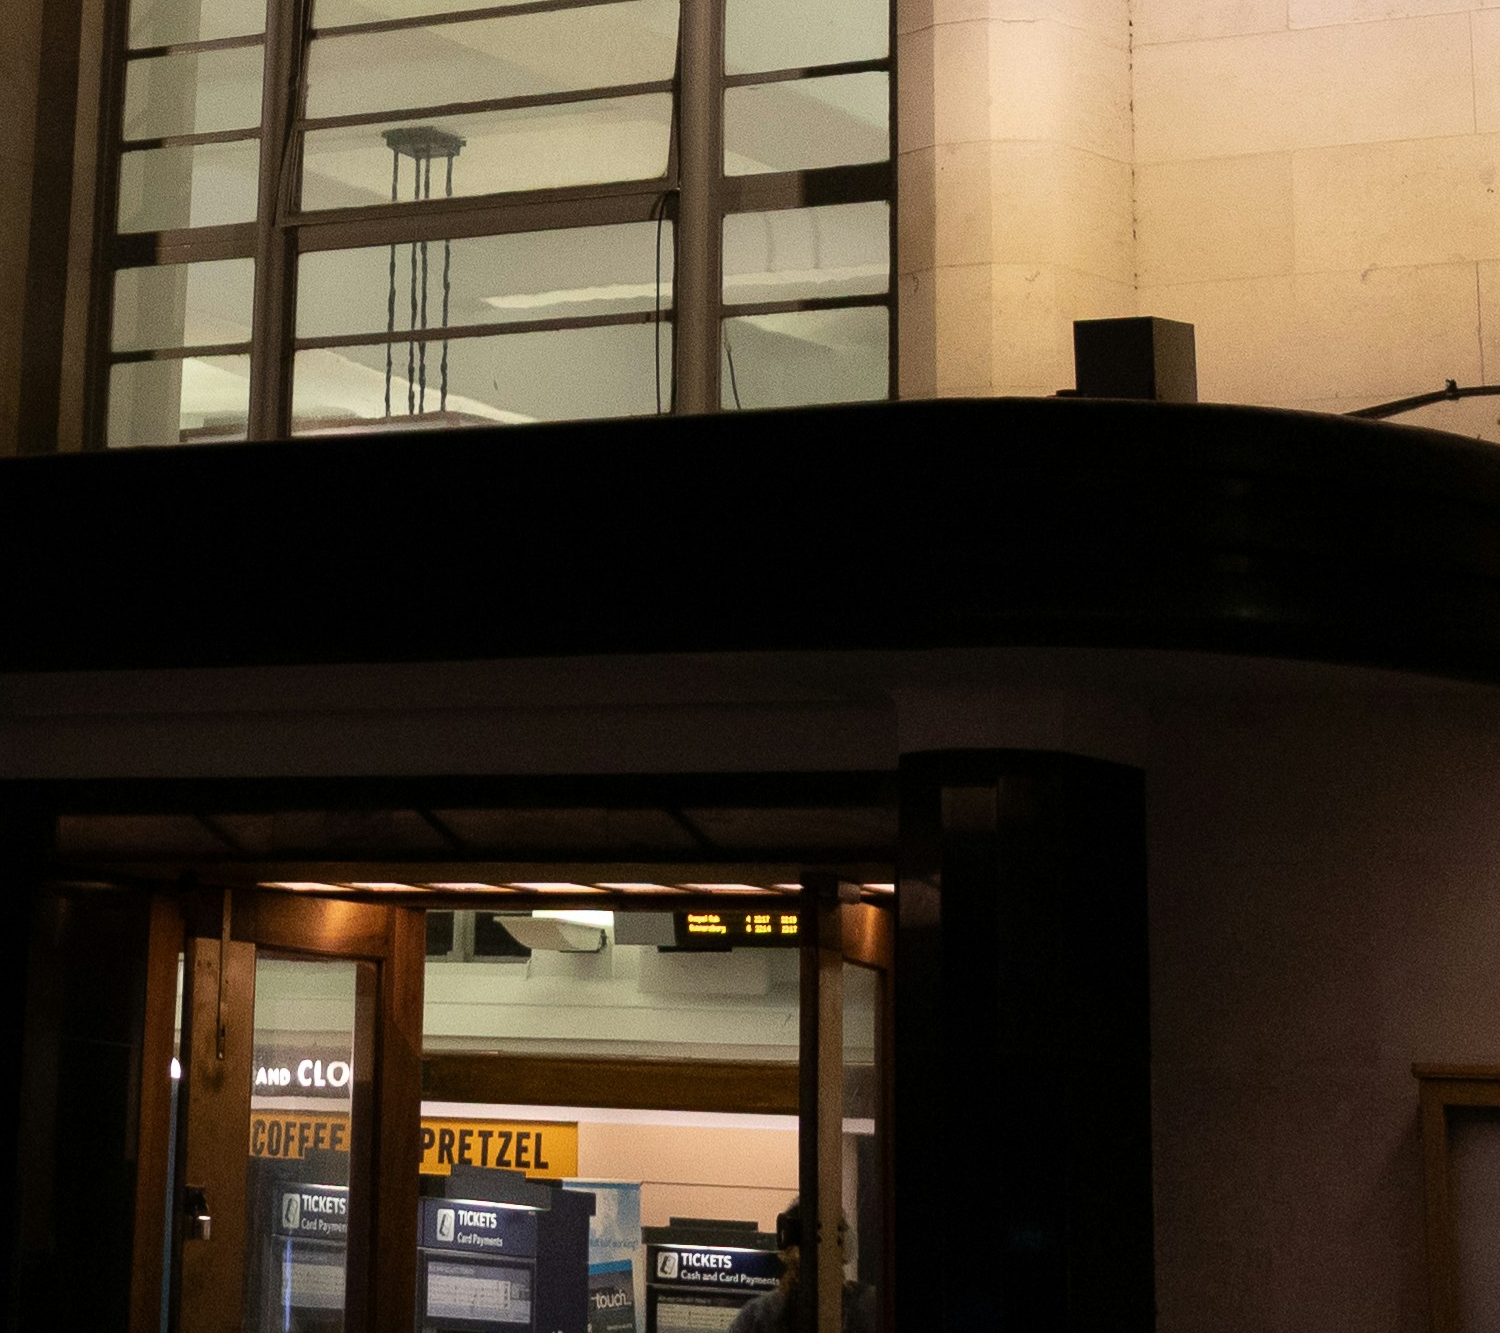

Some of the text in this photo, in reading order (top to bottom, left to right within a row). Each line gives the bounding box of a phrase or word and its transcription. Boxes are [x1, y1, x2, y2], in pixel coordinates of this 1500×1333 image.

[255, 1059, 350, 1087] AND CLO
[251, 1119, 549, 1170] COFFEE PRETZEL
[301, 1194, 347, 1215] TICKETS
[301, 1217, 318, 1231] Card
[458, 1209, 497, 1229] TICKETS
[457, 1232, 503, 1247] Card Payments
[680, 1252, 732, 1269] TICKETS
[681, 1269, 780, 1286] Cash and Card Payments
